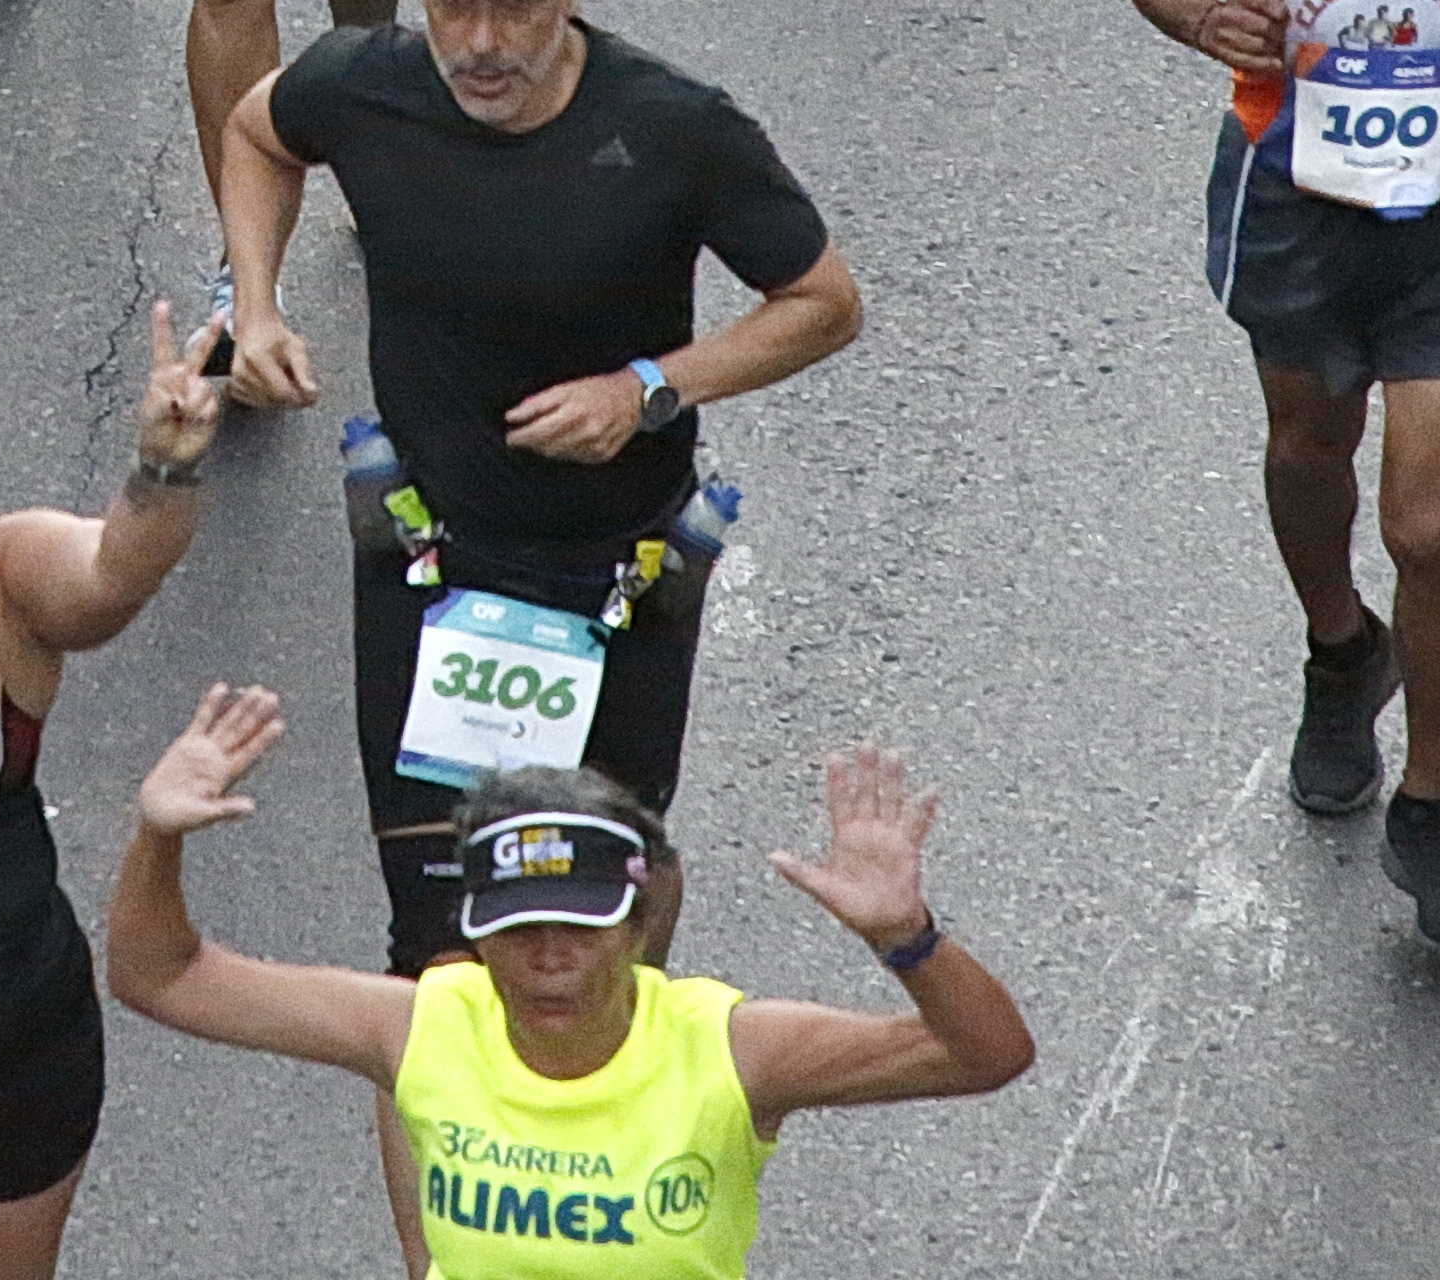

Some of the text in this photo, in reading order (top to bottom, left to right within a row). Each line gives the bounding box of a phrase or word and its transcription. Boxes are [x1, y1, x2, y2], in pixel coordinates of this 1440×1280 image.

[1320, 104, 1440, 149] 100
[432, 652, 577, 722] 3106
[461, 1139, 614, 1179] CARRERA
[426, 1163, 710, 1246] ALIMEX 10K
